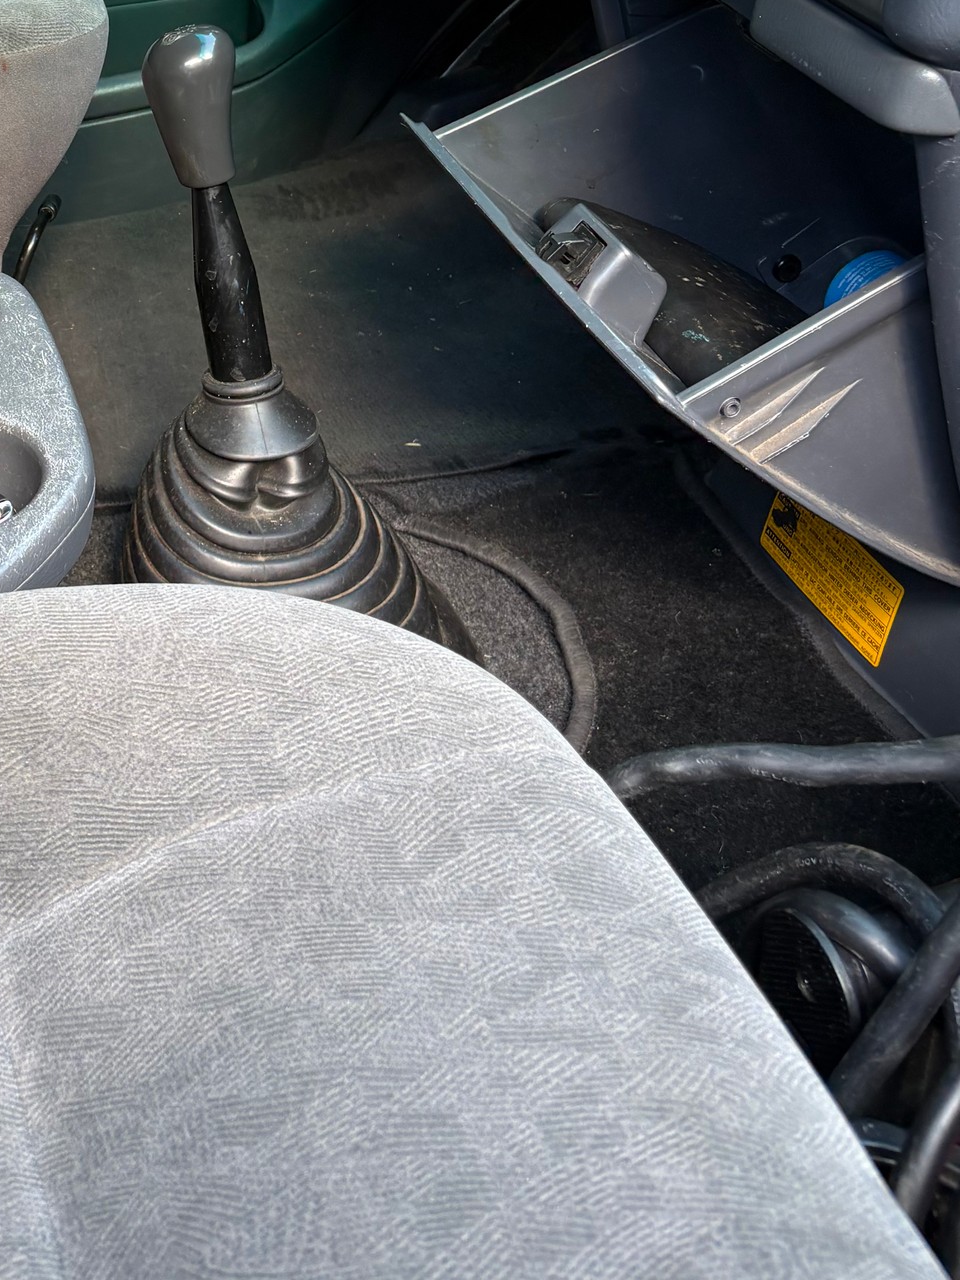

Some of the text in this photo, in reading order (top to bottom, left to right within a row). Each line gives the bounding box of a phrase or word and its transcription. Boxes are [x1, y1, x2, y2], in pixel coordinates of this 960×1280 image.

[766, 529, 791, 557] ATTENTION
[843, 564, 861, 583] BEHIND
[861, 582, 873, 594] THIS
[873, 594, 891, 613] COVER
[859, 603, 885, 632] ABDECKUNG
